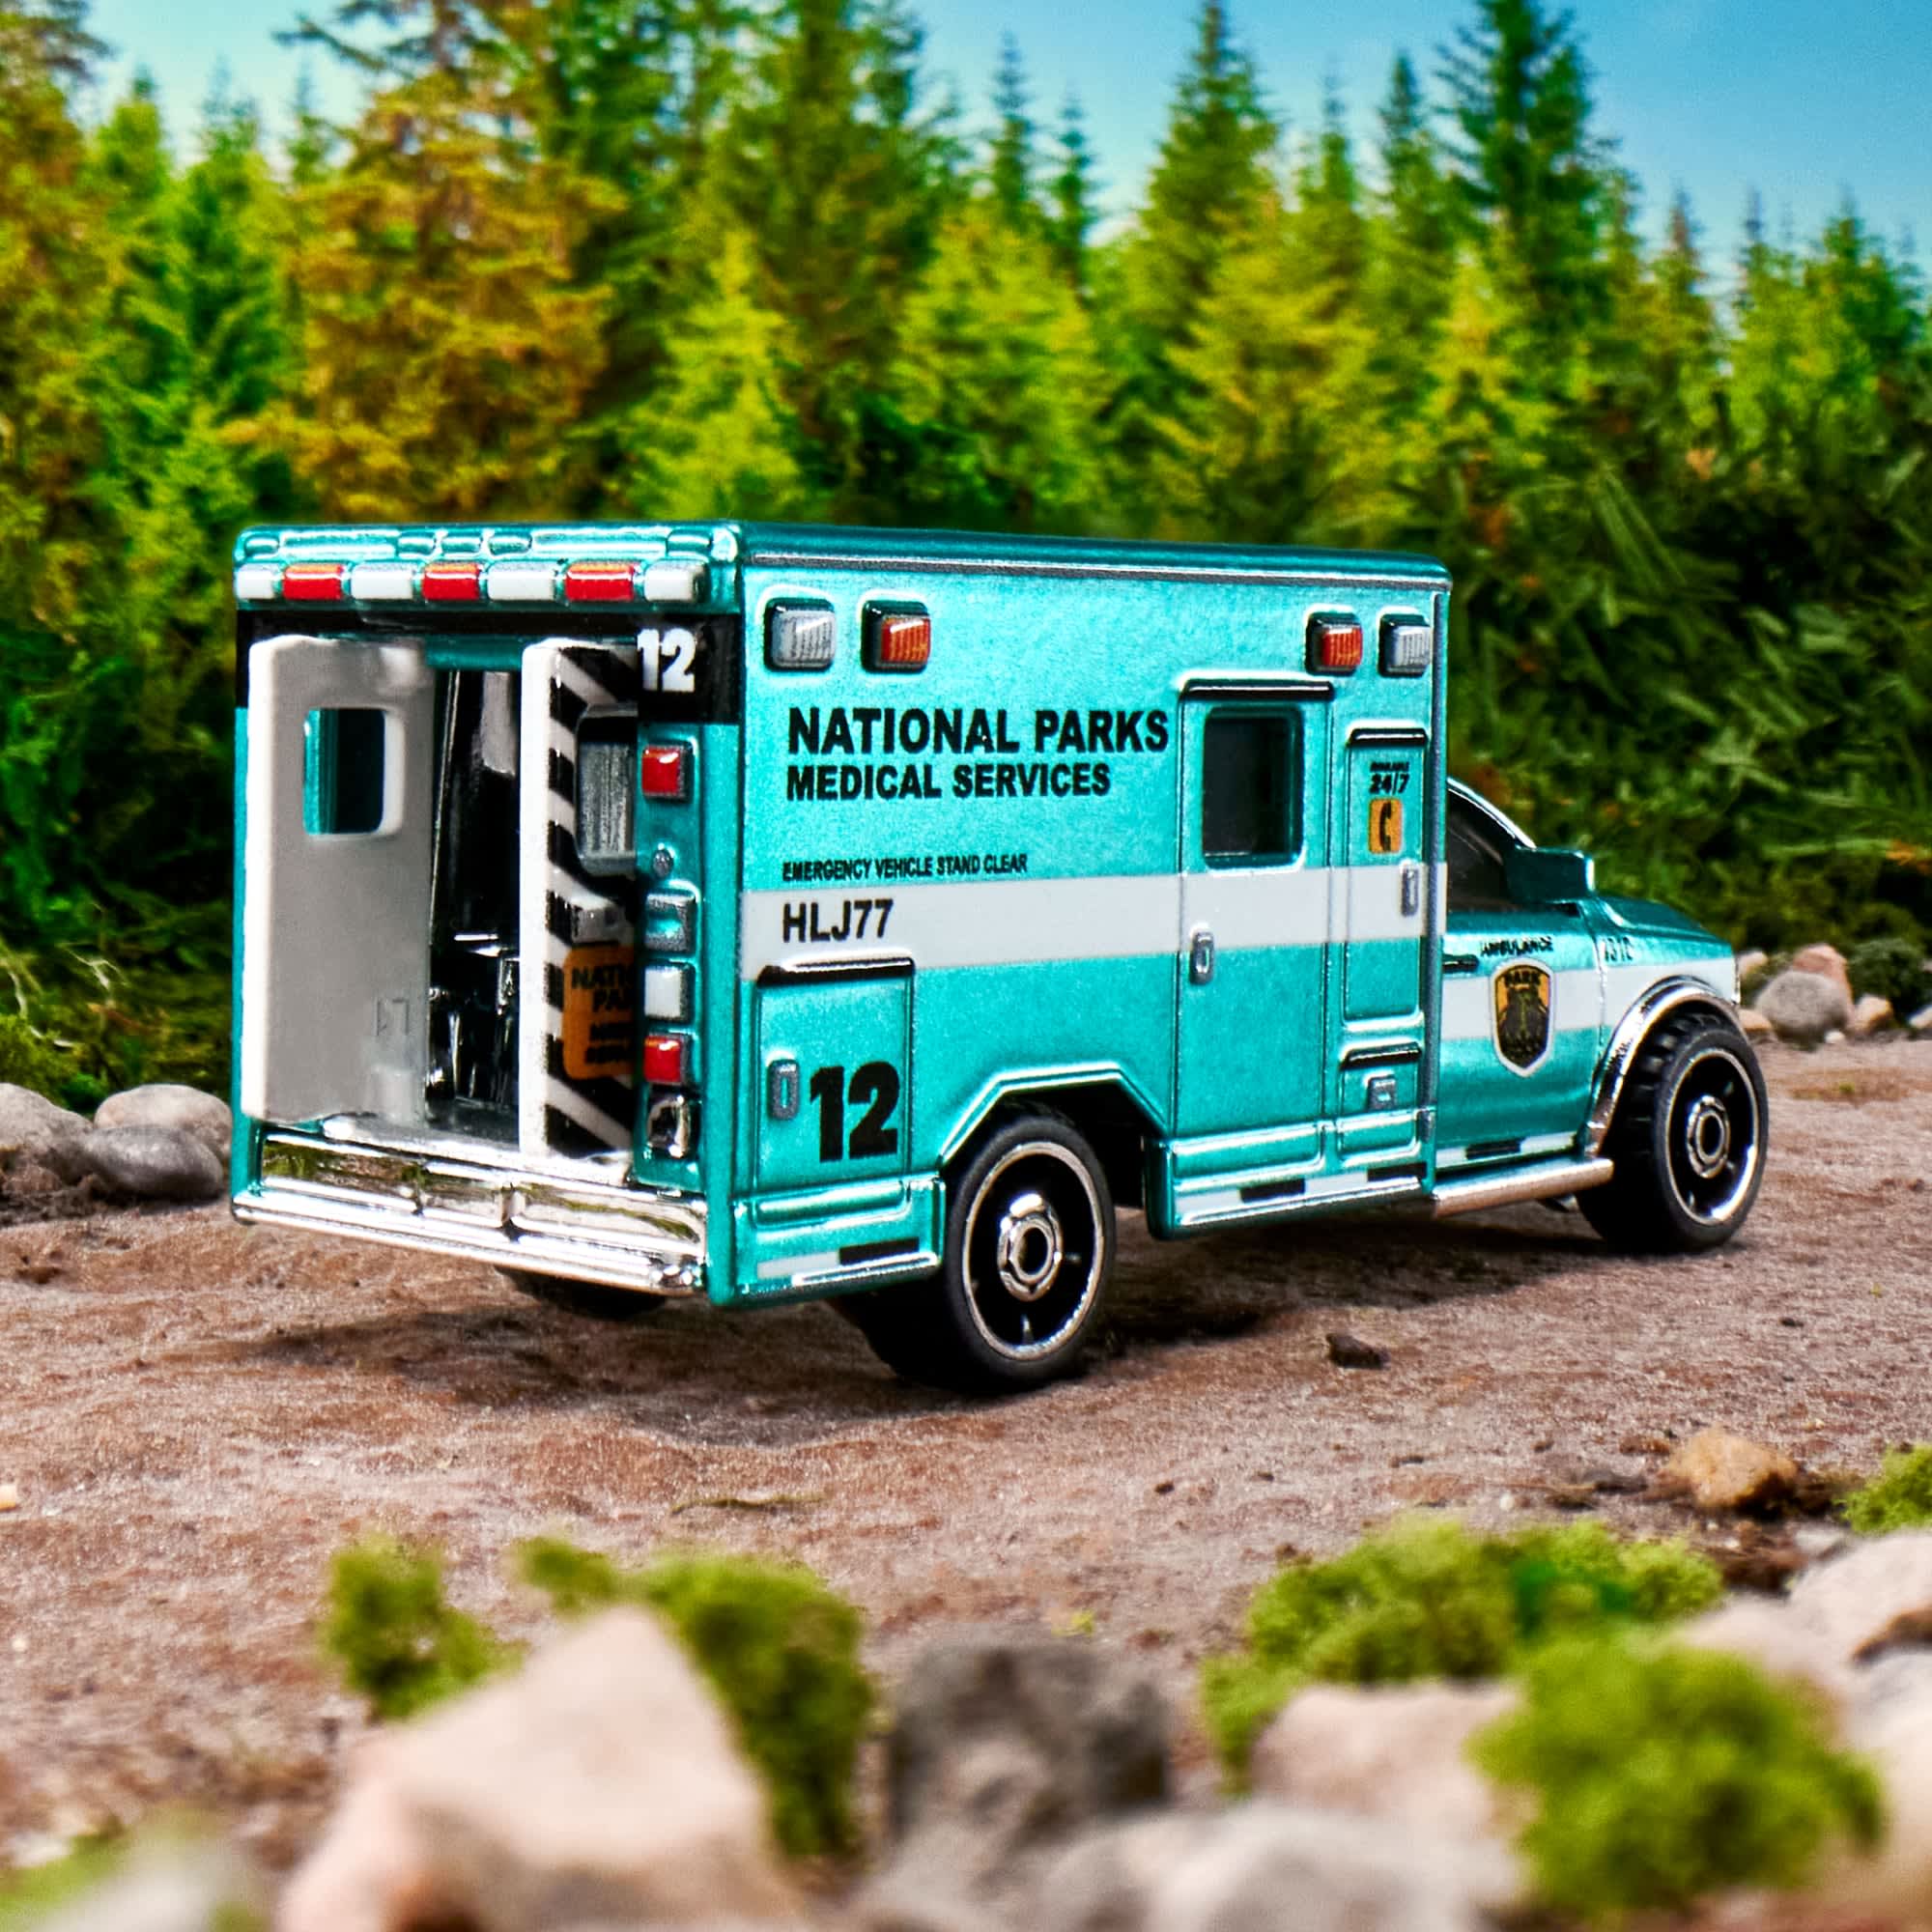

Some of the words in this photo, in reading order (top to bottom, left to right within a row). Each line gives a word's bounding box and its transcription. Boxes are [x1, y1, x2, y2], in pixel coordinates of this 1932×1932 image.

[637, 627, 696, 694] 12
[787, 706, 1020, 755] NATIONAL
[1035, 709, 1170, 753] PARKS
[786, 763, 943, 802] MEDICAL
[952, 762, 1111, 800] SERVICES
[781, 859, 872, 883] EMERGENCY
[874, 856, 933, 879] VEHICLE
[936, 855, 981, 876] STAND
[982, 853, 1029, 874] CLEAR
[781, 898, 895, 944] HLJ77
[810, 1060, 900, 1164] 12
